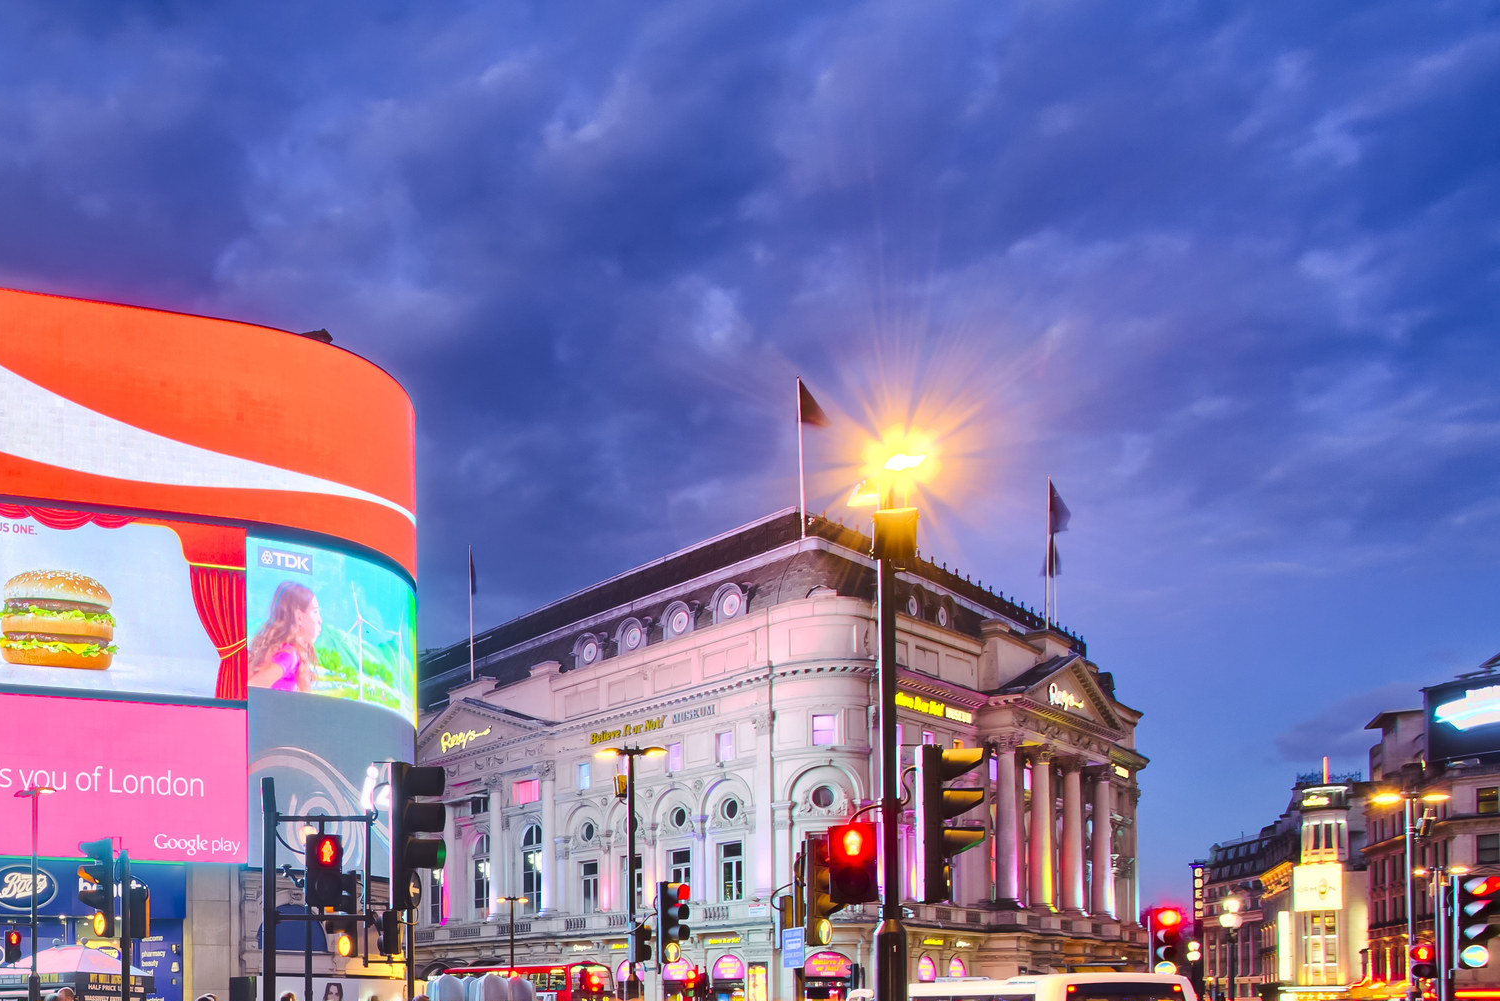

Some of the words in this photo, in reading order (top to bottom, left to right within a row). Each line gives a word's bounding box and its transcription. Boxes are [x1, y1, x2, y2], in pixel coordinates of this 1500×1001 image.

[12, 523, 38, 536] ONE.
[272, 551, 310, 572] TDK
[590, 729, 621, 745] Believe
[632, 723, 643, 735] or
[19, 768, 67, 791] you
[76, 766, 103, 793] of
[109, 768, 204, 797] London
[153, 833, 209, 856] Google
[211, 835, 241, 856] play
[88, 984, 102, 992] HALF
[102, 984, 117, 992] PRICE
